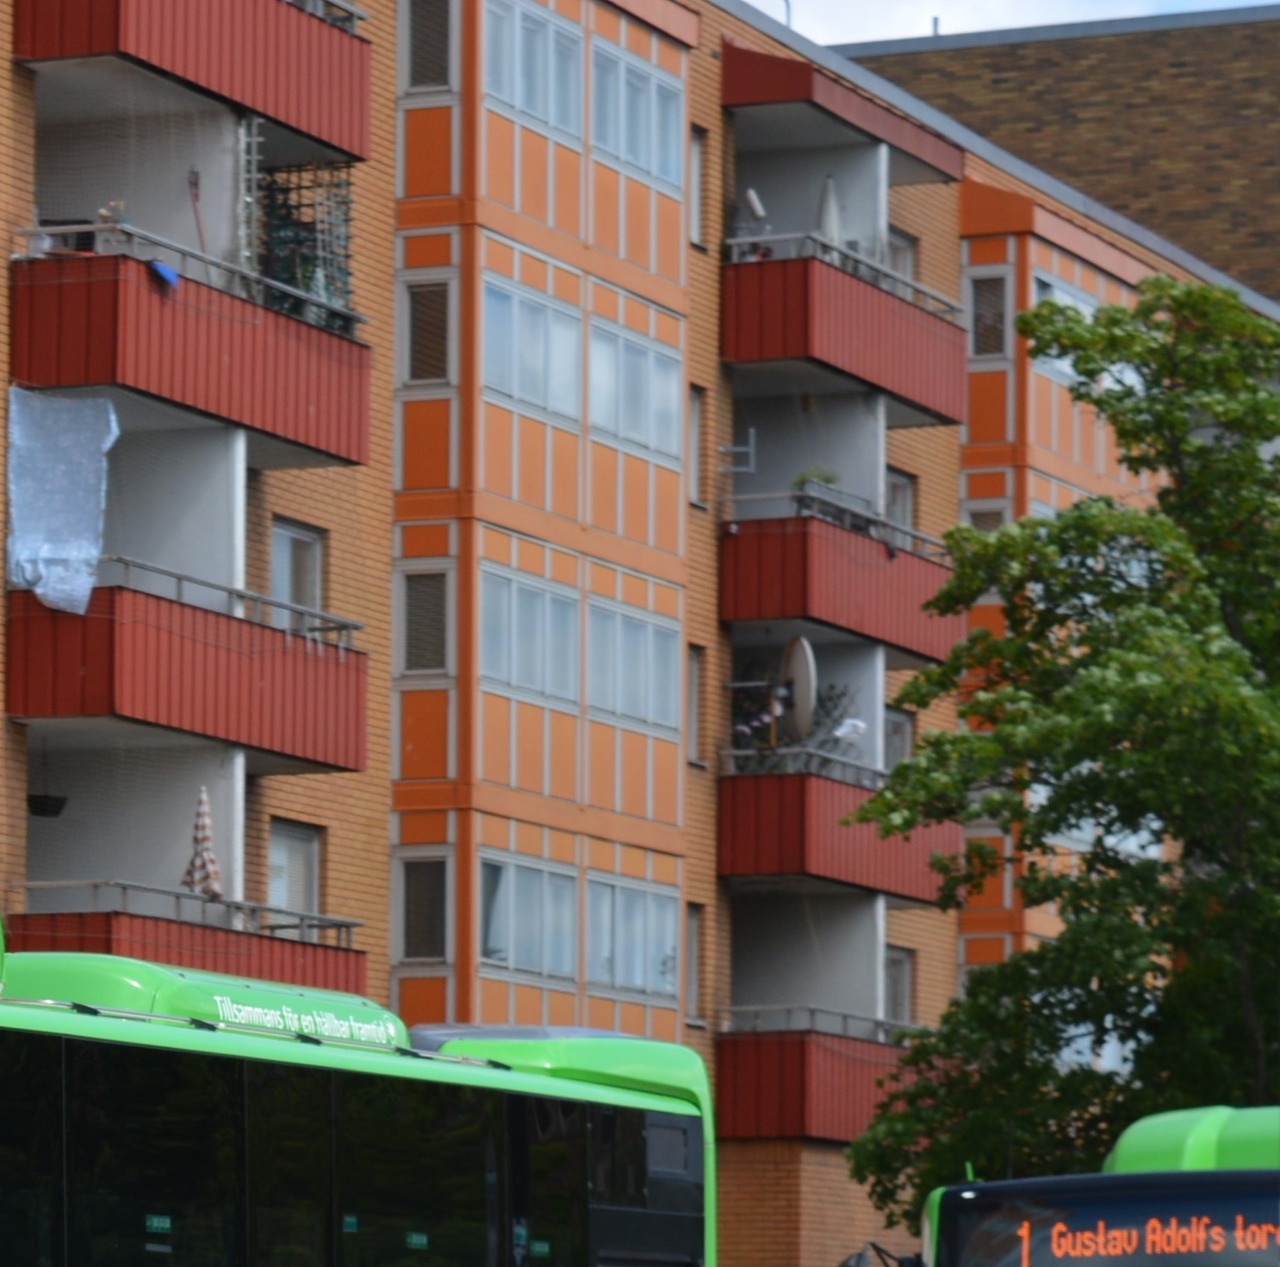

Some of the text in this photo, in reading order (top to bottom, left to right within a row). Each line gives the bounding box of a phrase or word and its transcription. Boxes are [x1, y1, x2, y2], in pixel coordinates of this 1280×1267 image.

[214, 995, 387, 1044] Tillsammans för en hållbar framtid
[1050, 1219, 1139, 1258] Gustav
[1144, 1215, 1226, 1254] Adolfs
